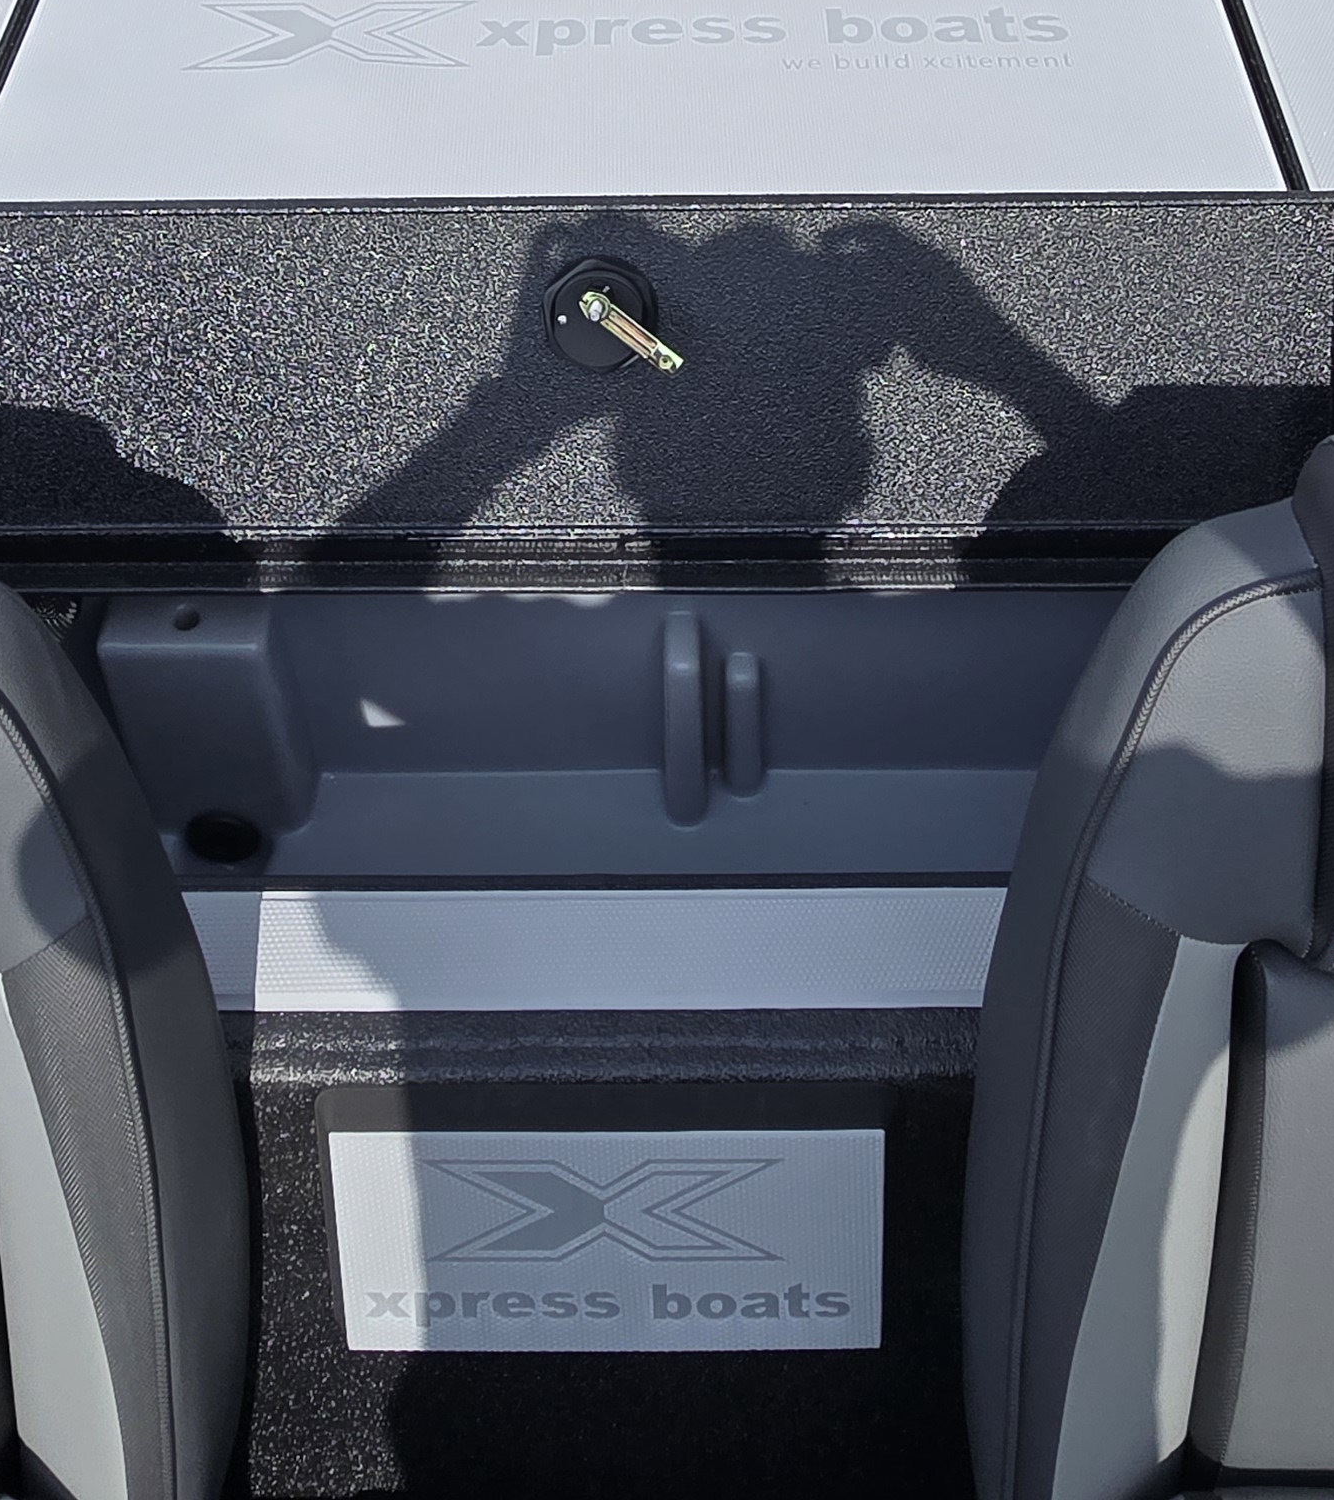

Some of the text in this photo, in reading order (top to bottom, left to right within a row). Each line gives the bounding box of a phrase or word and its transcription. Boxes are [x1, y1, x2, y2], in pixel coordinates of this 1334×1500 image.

[475, 15, 788, 56] xpress
[824, 7, 1069, 44] boats
[781, 53, 1072, 71] we build xcitement
[368, 1282, 852, 1328] xpress boats
